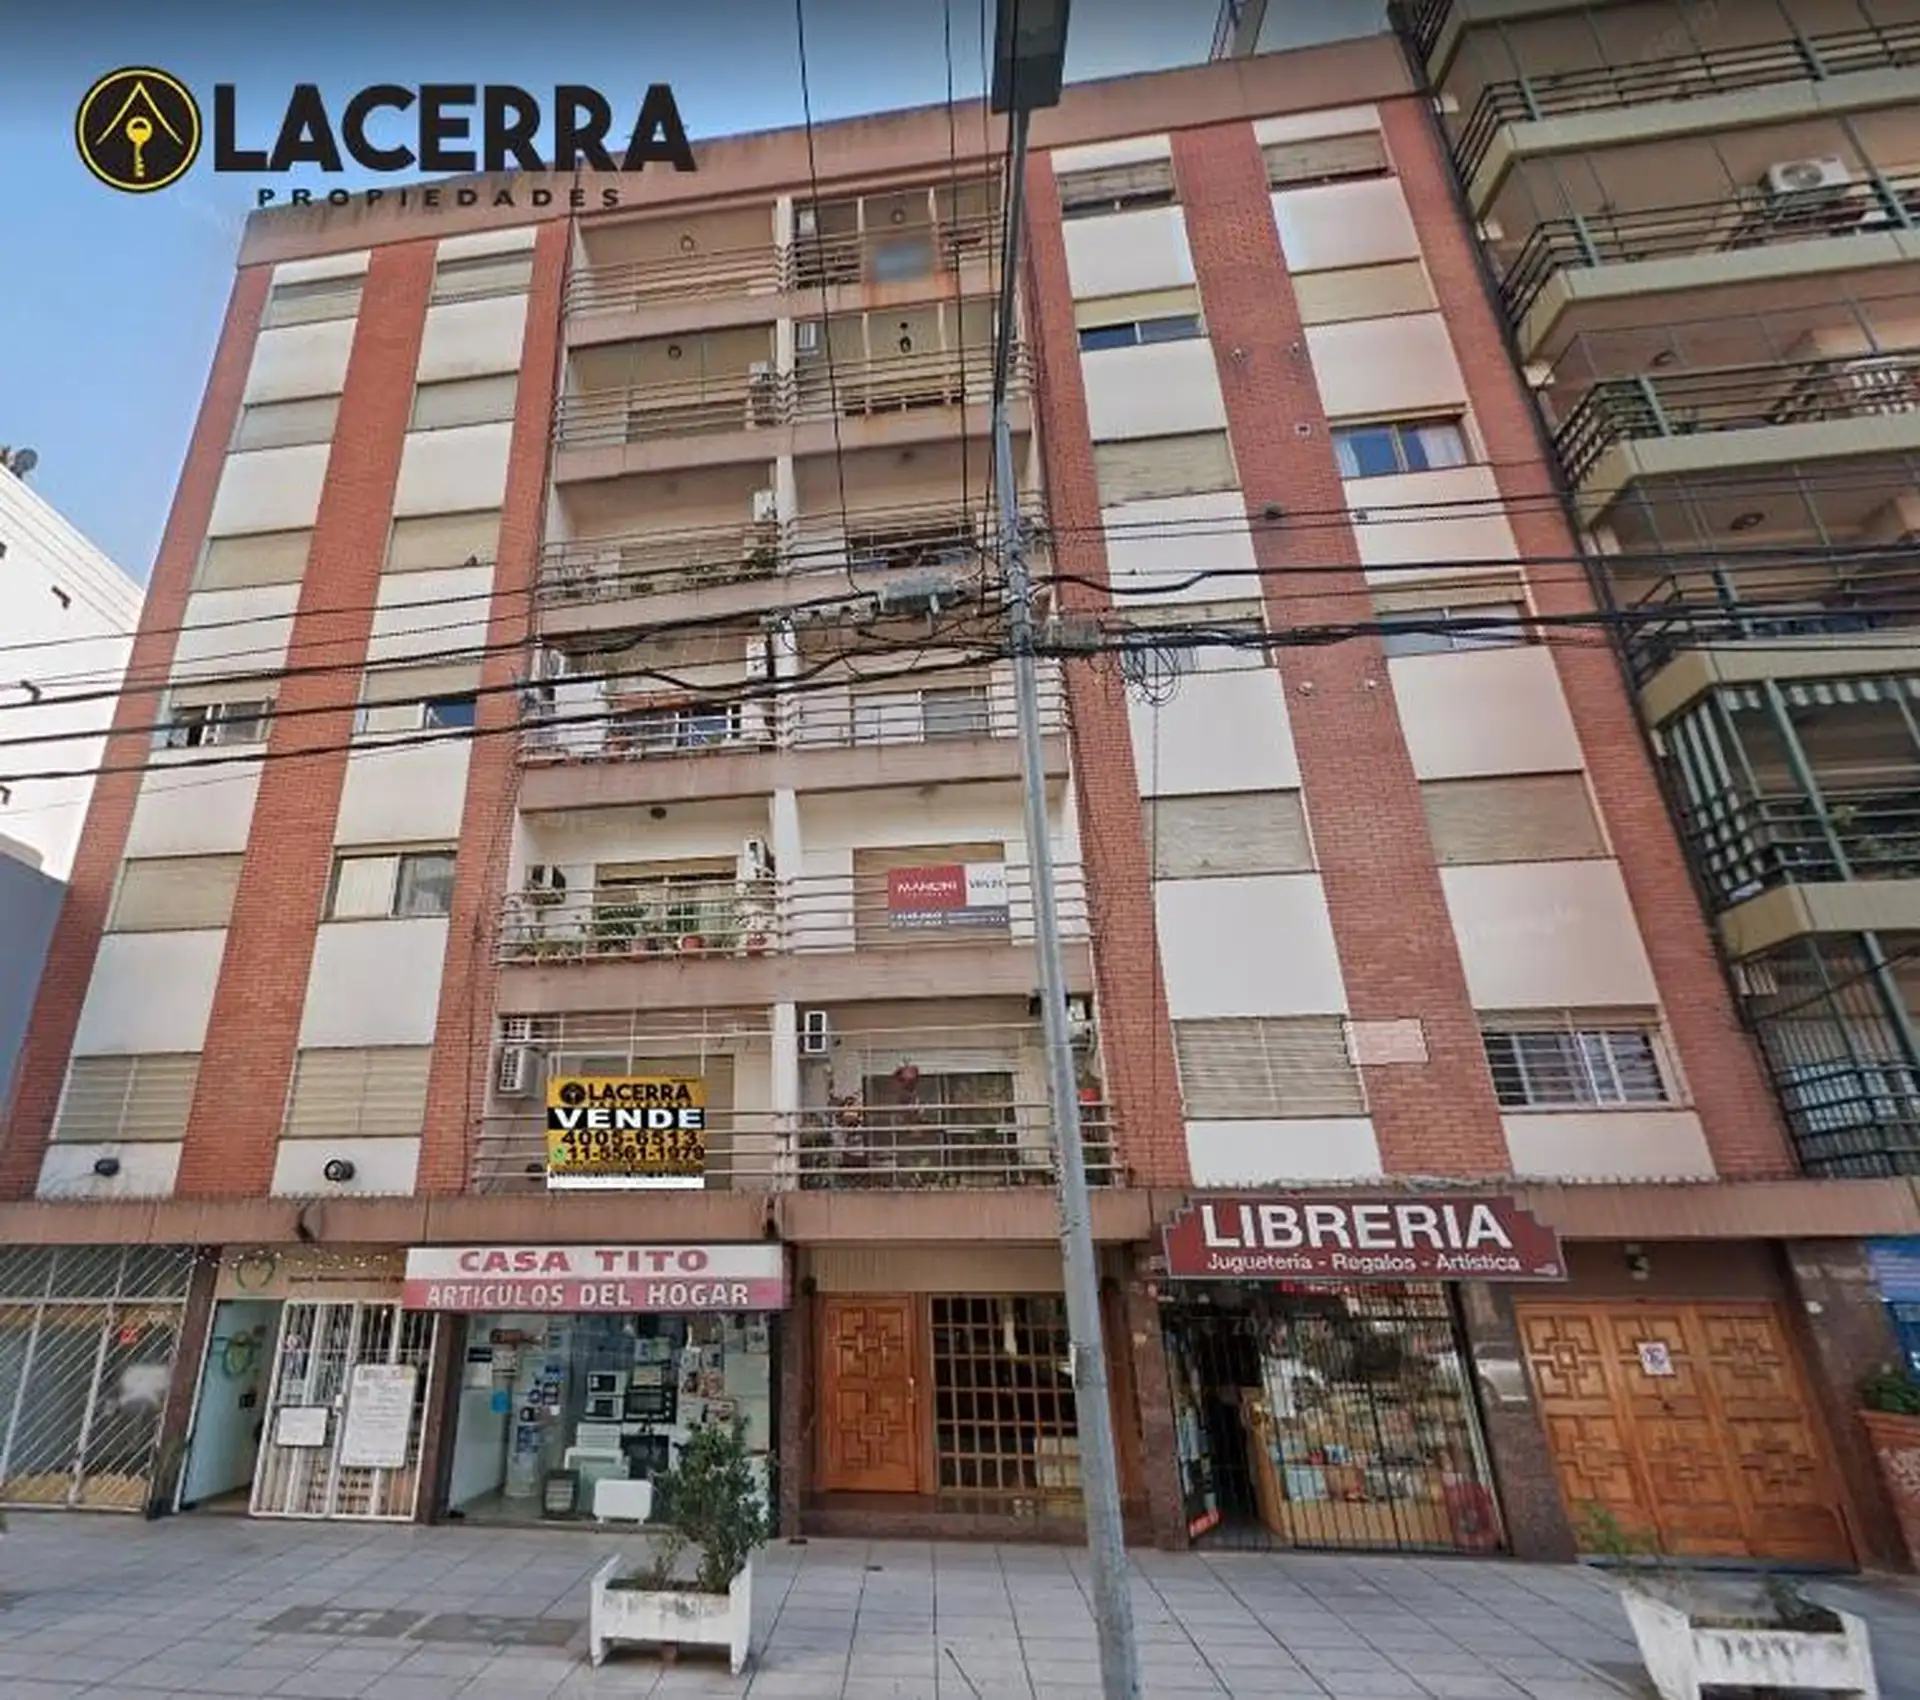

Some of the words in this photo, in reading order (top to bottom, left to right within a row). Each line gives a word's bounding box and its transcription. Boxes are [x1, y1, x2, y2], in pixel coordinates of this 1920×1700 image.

[588, 1083, 692, 1100] LACERRA
[554, 1109, 701, 1128] VENDE
[1202, 1204, 1512, 1249] LIBRERIA
[459, 1250, 570, 1273] CASA
[594, 1249, 709, 1272] TITO
[1331, 1252, 1417, 1274] Regalos
[426, 1284, 564, 1308] ARTICULOS
[579, 1284, 631, 1307] DEL
[647, 1283, 749, 1306] HOGAR
